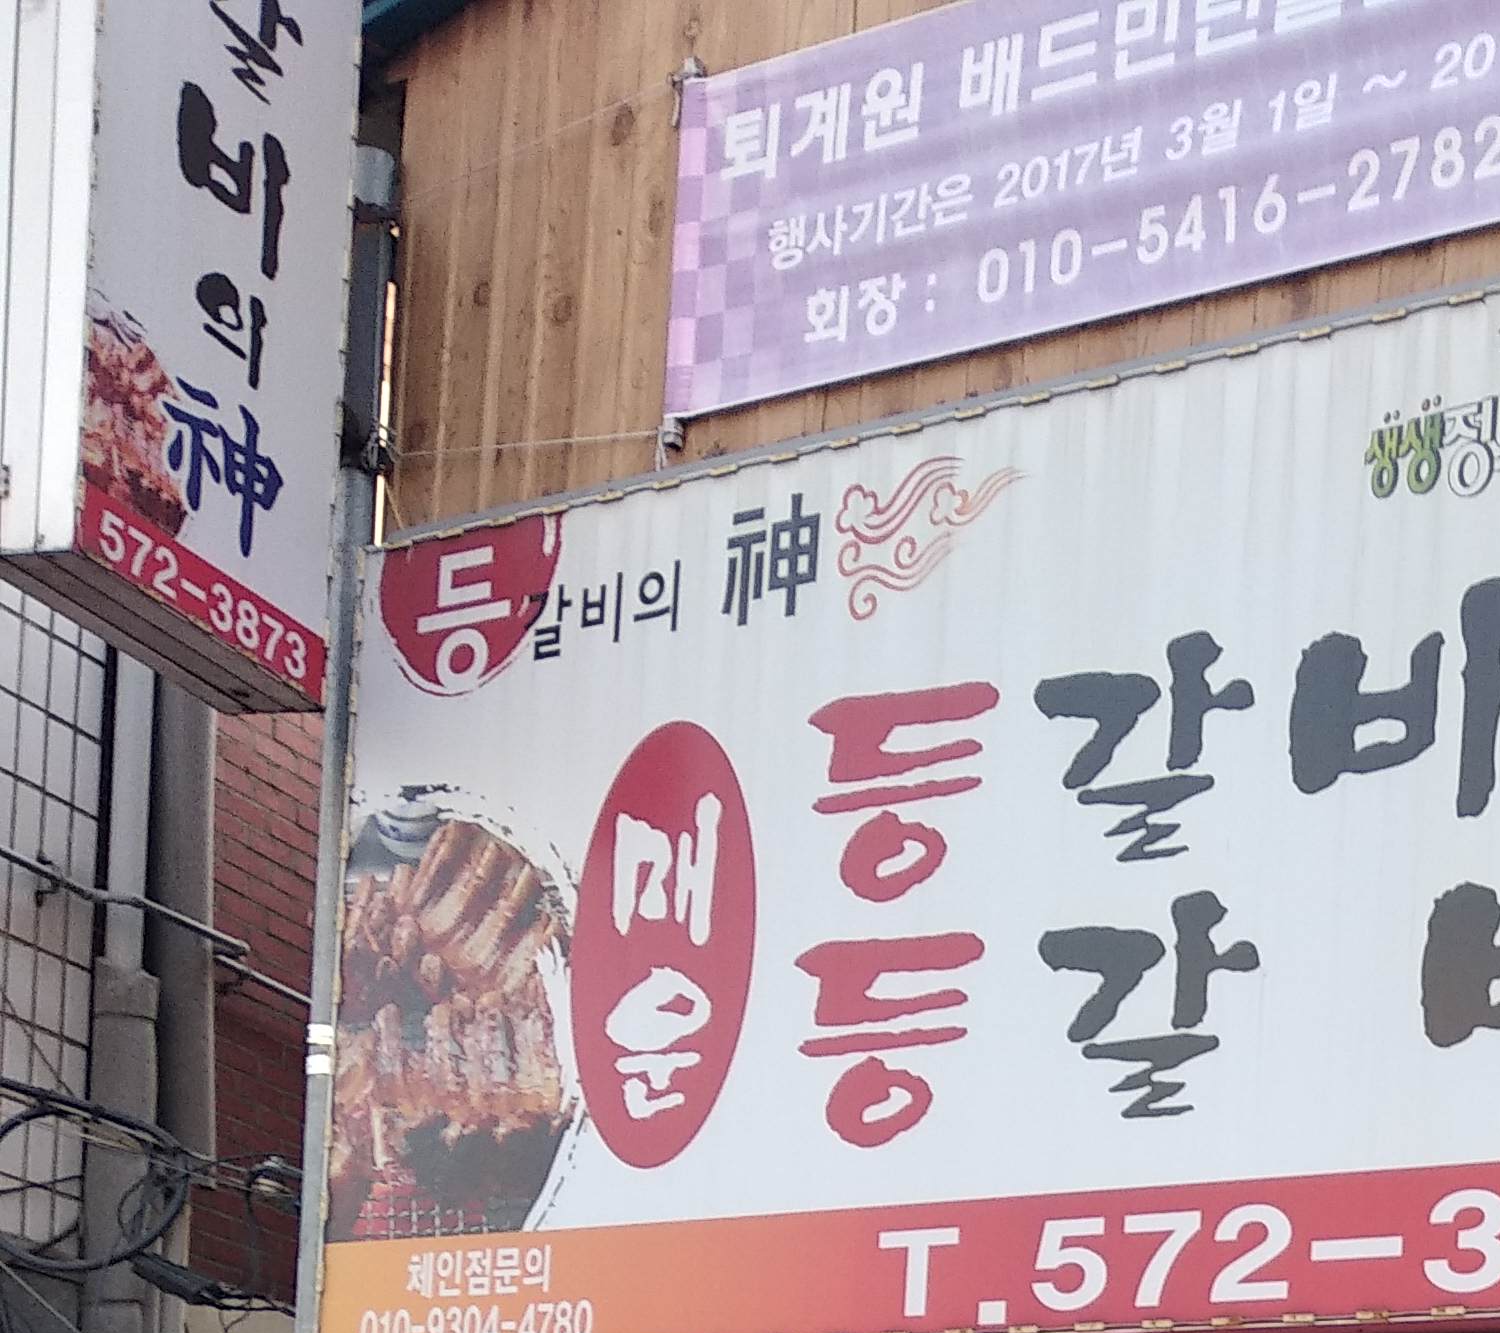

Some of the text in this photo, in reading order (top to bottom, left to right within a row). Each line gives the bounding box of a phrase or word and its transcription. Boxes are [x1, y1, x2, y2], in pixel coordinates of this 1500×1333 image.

[719, 62, 924, 181] 퇴계원
[767, 174, 974, 271] 행사기간은
[993, 126, 1142, 208] 2017년
[1165, 98, 1241, 162] 3월
[1267, 72, 1339, 135] 1일
[804, 273, 907, 344] 회장
[98, 509, 309, 681] 572-3873
[720, 492, 822, 628] 神
[604, 793, 713, 1119] 매운
[406, 1244, 552, 1299] 체인점문의
